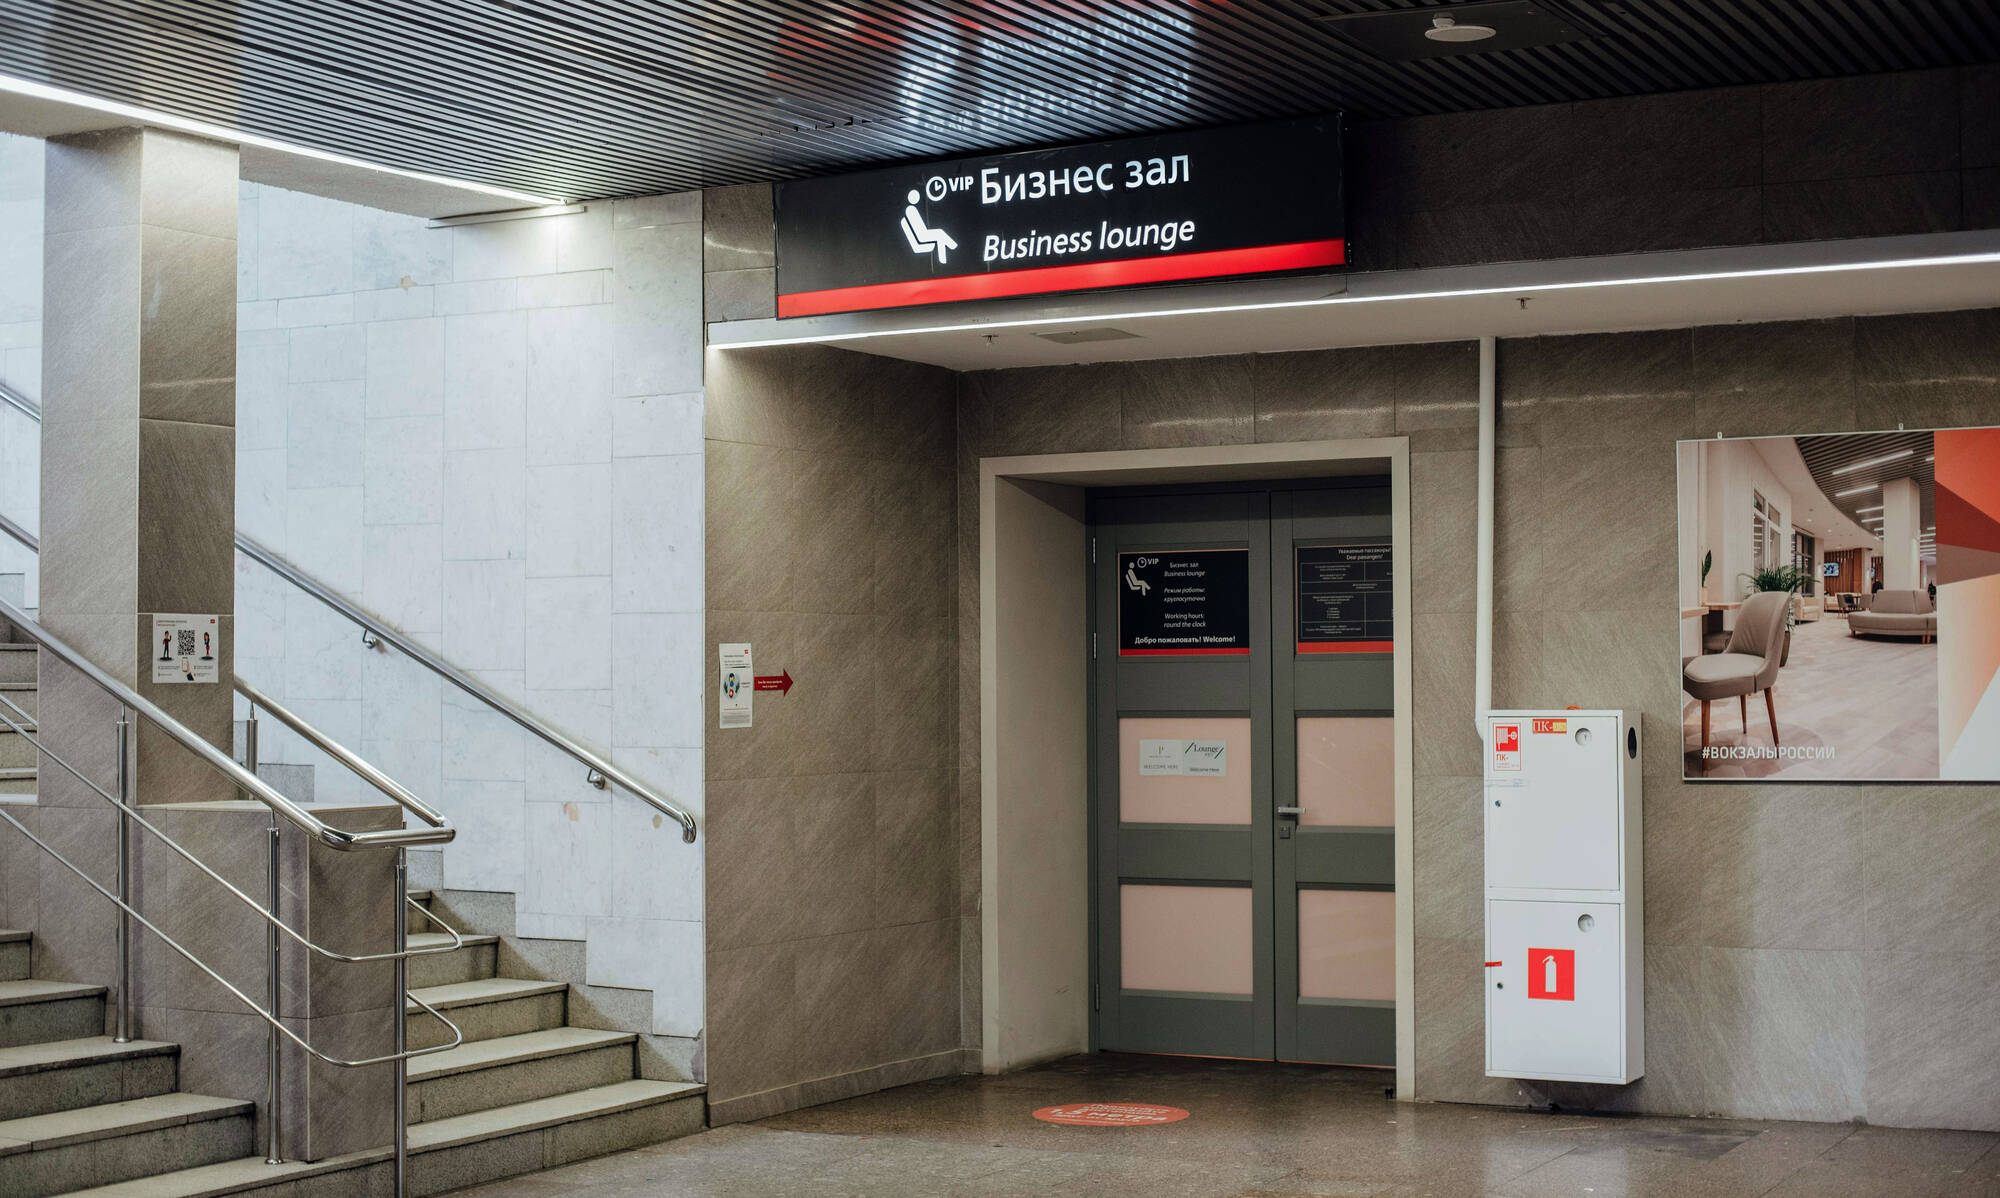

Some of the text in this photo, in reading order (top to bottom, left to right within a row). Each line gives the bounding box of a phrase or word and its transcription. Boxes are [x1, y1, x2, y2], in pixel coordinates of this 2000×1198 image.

[948, 175, 974, 192] VIP
[980, 154, 1190, 205] Бизнес зал
[983, 220, 1195, 262] Business lounge
[1164, 612, 1188, 620] Working
[1134, 635, 1236, 645] Добро пожаловать! Welcome!
[1702, 746, 1836, 759] #ВОКЗАЛЫРОССИИ
